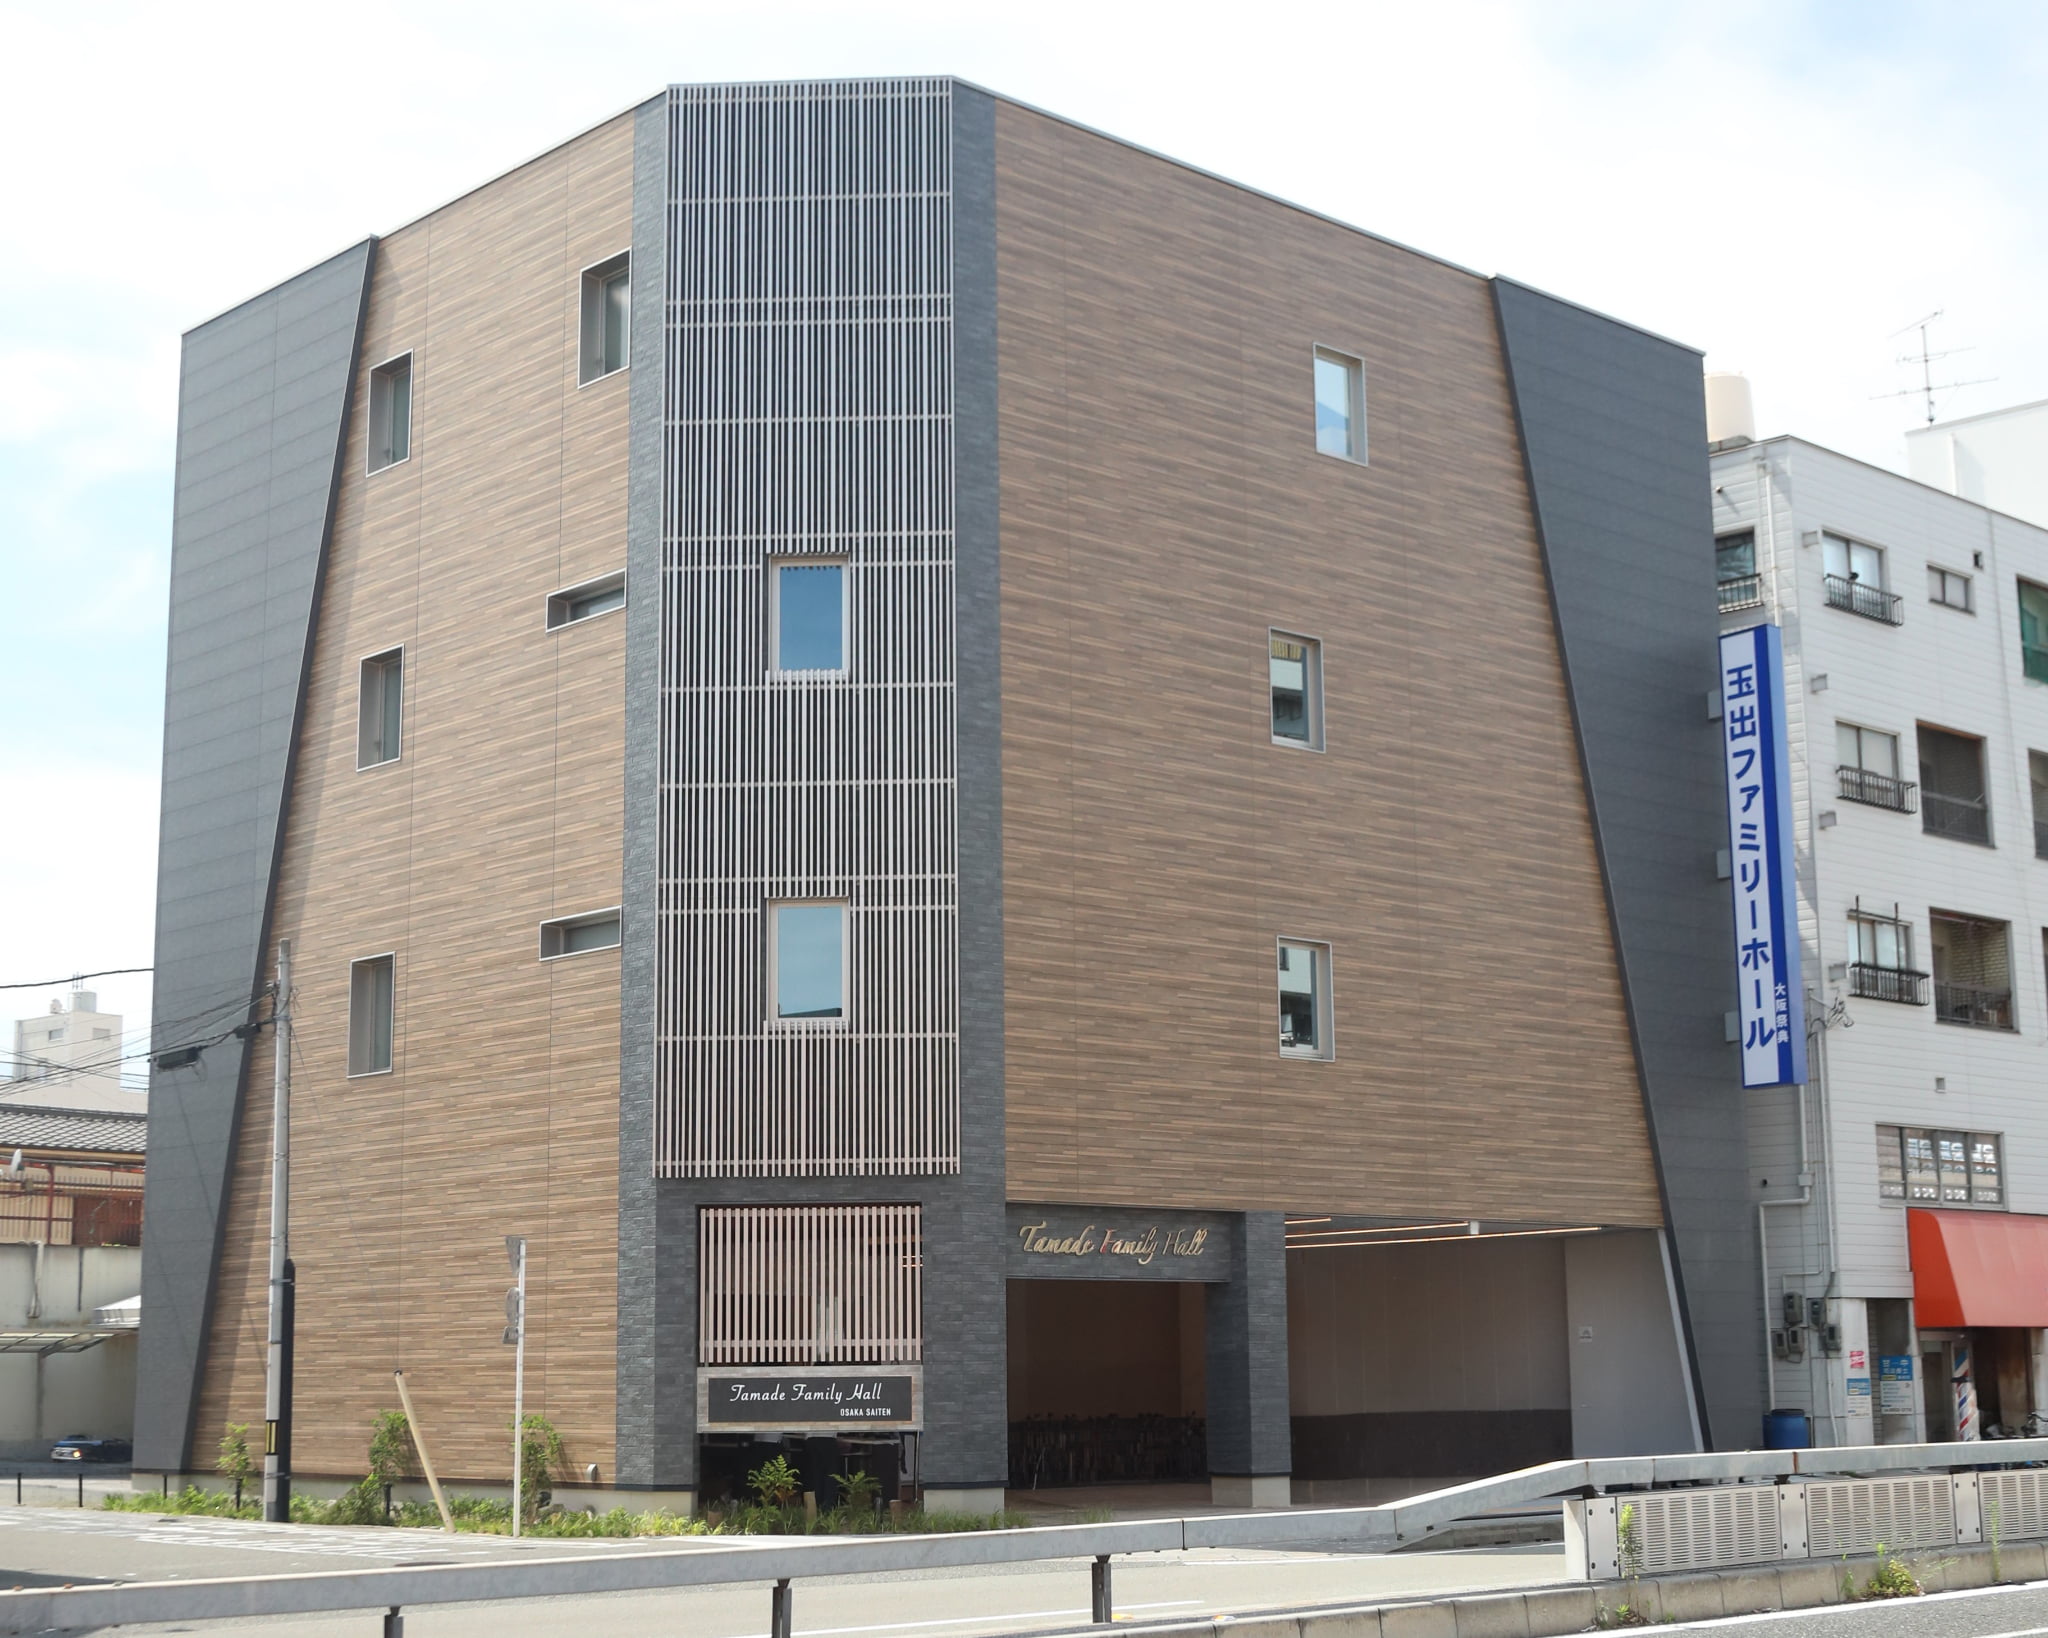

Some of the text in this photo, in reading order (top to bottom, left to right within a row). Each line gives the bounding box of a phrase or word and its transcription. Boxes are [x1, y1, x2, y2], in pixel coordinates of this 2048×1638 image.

[1726, 663, 1775, 1050] 玉出ファミリーホール
[1019, 1220, 1208, 1265] Tamade Family Hall
[730, 1382, 882, 1405] Tamade Family Hall
[840, 1407, 891, 1417] OSAKA SAITEN
